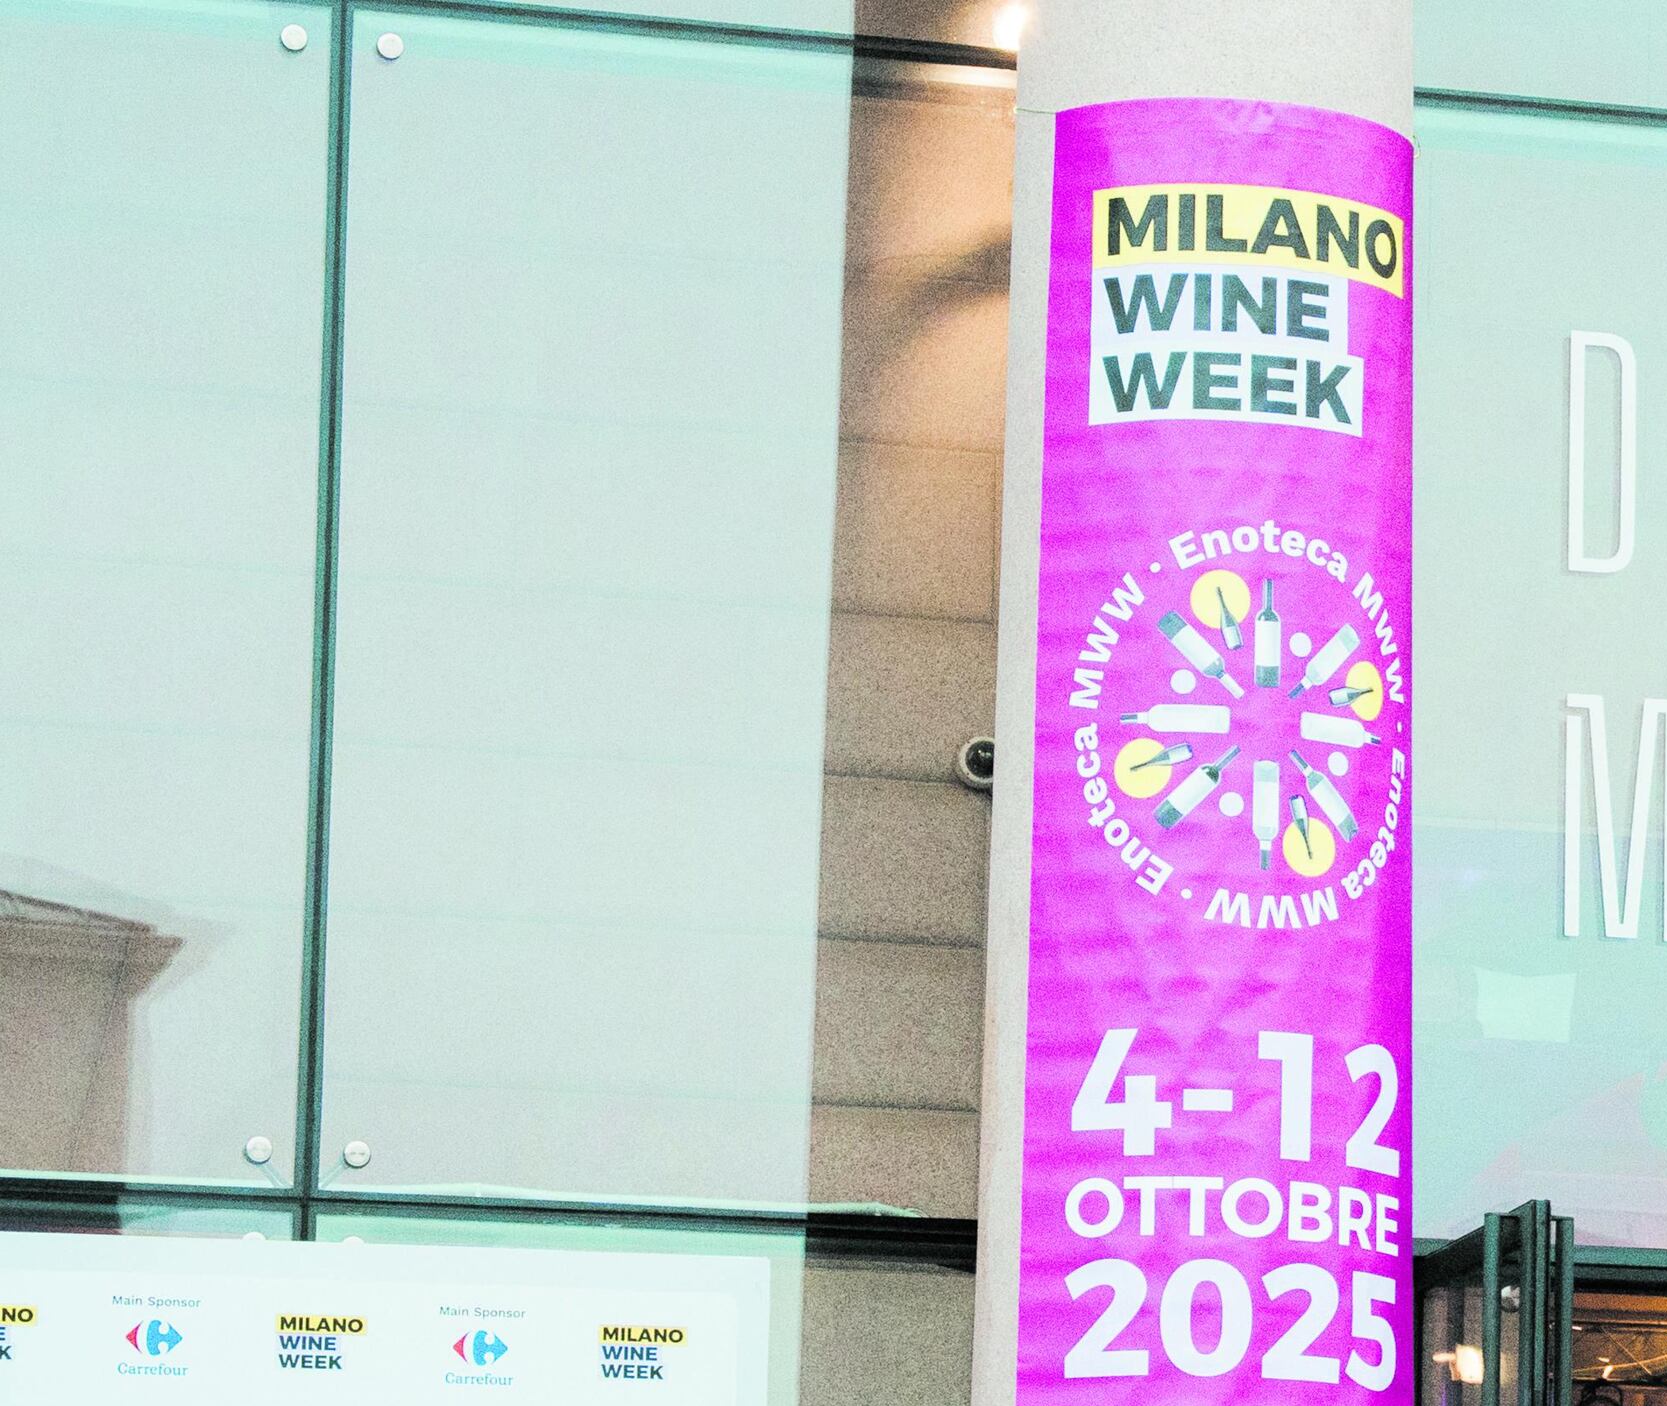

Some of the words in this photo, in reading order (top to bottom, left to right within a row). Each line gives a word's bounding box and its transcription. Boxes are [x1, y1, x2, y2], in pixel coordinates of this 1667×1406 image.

[1107, 194, 1397, 279] MILANO
[1104, 272, 1330, 342] WINE
[1102, 351, 1352, 425] WEEK
[1168, 520, 1349, 582] Enoteca
[1351, 572, 1405, 704] MWW
[1069, 572, 1145, 710] MWW
[1073, 722, 1175, 895] Enoteca
[1340, 747, 1405, 899] Enoteca
[1203, 887, 1340, 929] MWW
[1071, 1028, 1399, 1178] 4-12
[1065, 1176, 1398, 1257] OTTOBRE
[113, 1296, 142, 1305] Main
[148, 1297, 200, 1308] Sponsor
[440, 1306, 468, 1316] Main
[474, 1307, 525, 1319] Sponsor
[279, 1336, 336, 1351] WINE
[281, 1317, 363, 1332] MILANO
[603, 1327, 683, 1343] MILANO
[1063, 1258, 1396, 1392] 2025
[117, 1363, 188, 1375] Carrefour
[279, 1354, 341, 1369] WEEK
[601, 1364, 663, 1379] WEEK
[602, 1346, 657, 1361] WINE
[446, 1372, 513, 1385] Carrefour
